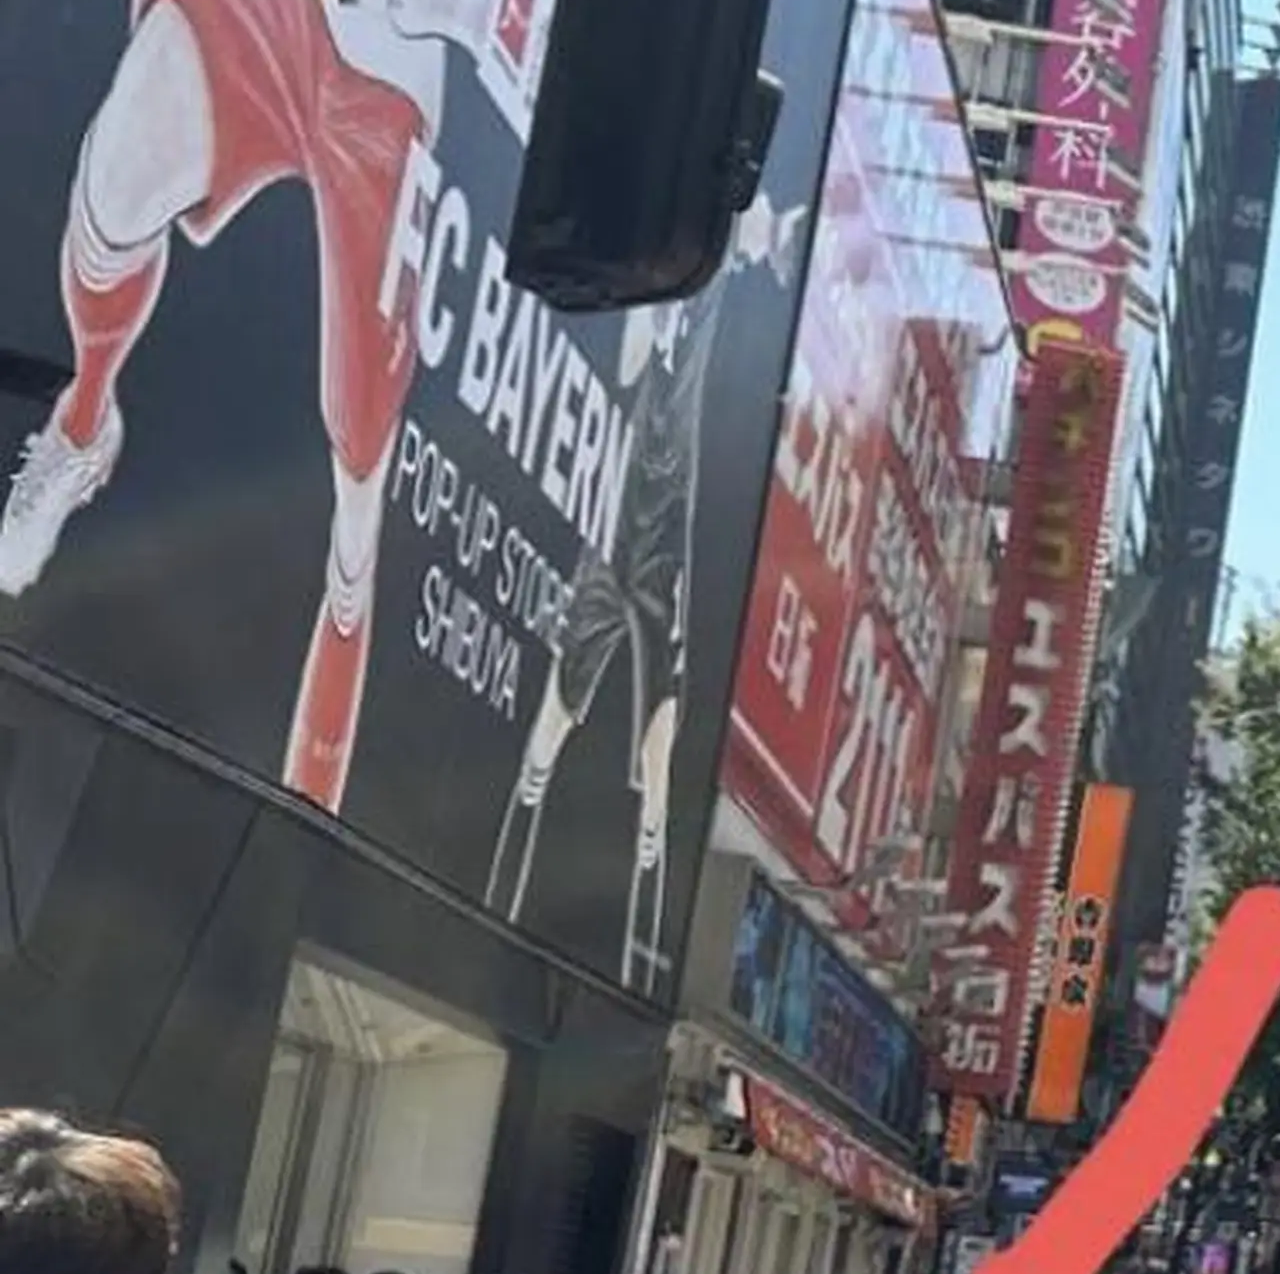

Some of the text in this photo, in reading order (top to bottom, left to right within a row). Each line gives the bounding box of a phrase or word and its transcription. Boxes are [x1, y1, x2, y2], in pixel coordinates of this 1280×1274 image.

[380, 137, 635, 567] FC BAYERN
[391, 419, 499, 576] POP-UP
[415, 564, 520, 722] SHIBUYA
